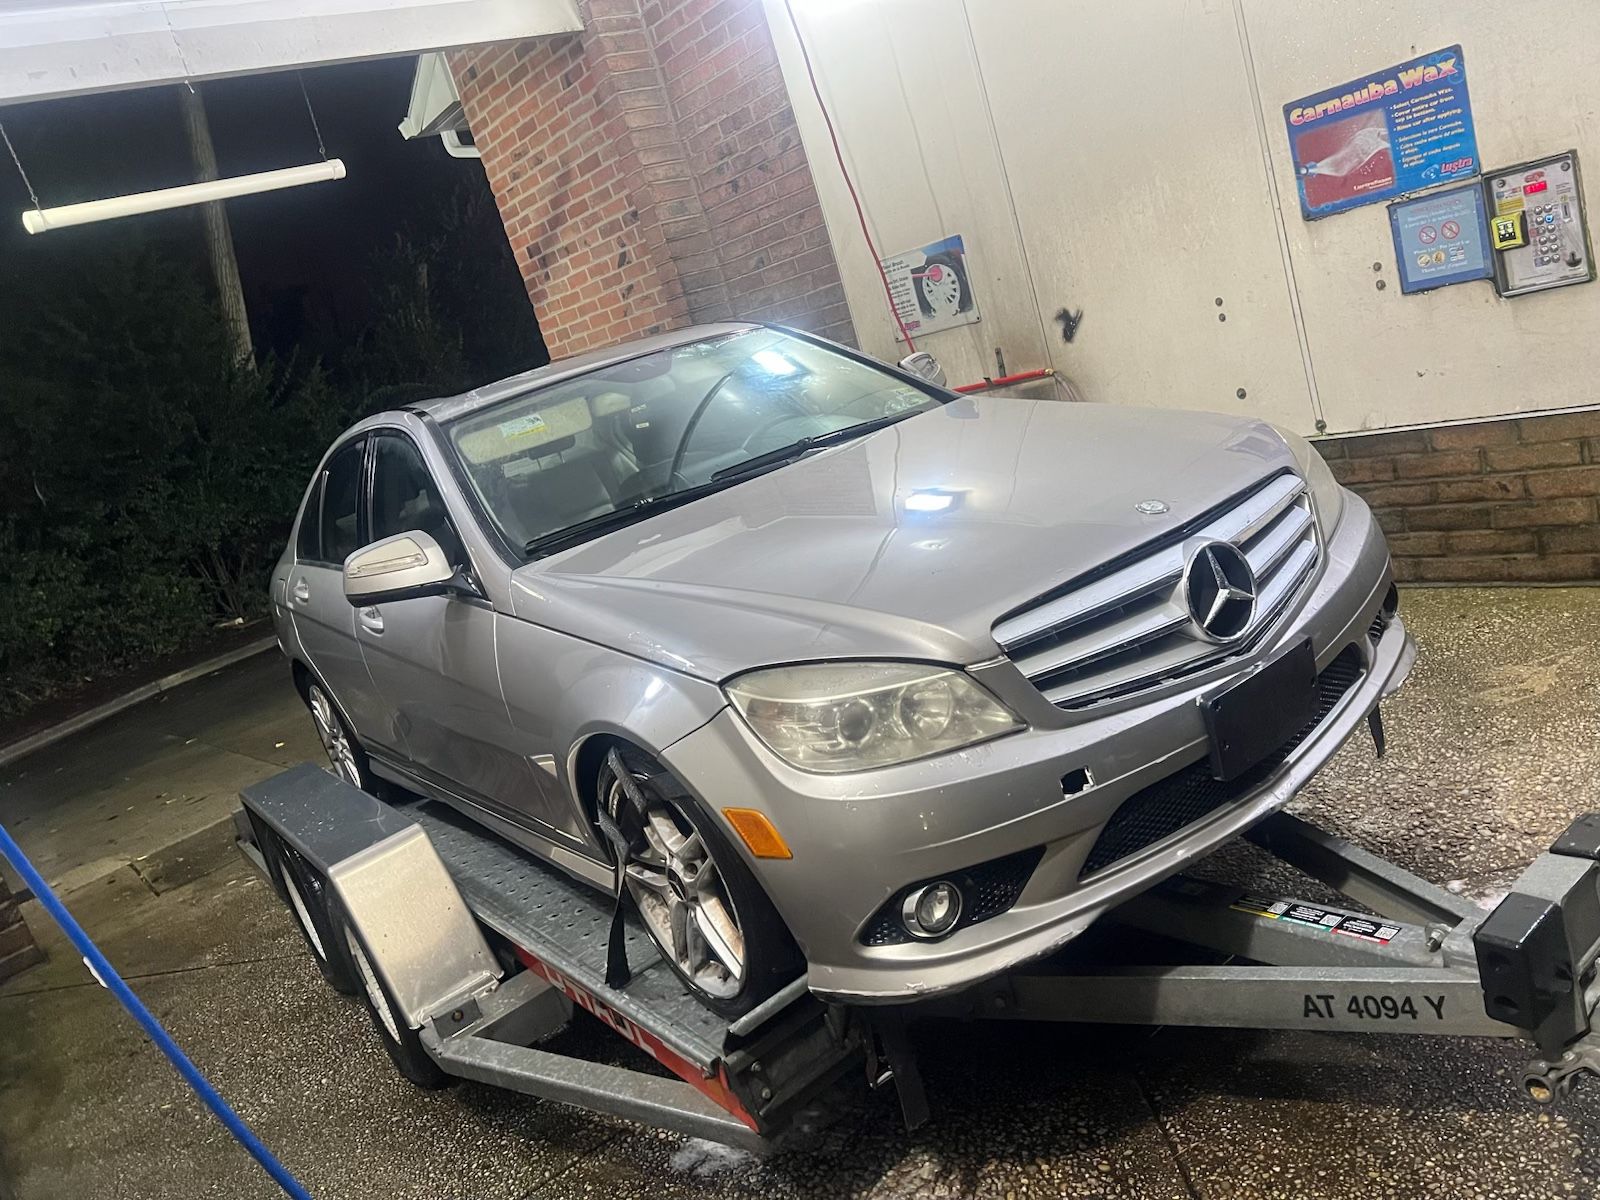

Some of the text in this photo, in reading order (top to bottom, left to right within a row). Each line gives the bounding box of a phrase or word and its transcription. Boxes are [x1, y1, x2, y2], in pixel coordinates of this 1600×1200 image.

[1290, 58, 1457, 126] Carnauba Wax
[1303, 995, 1446, 1020] AT 4094 Y
